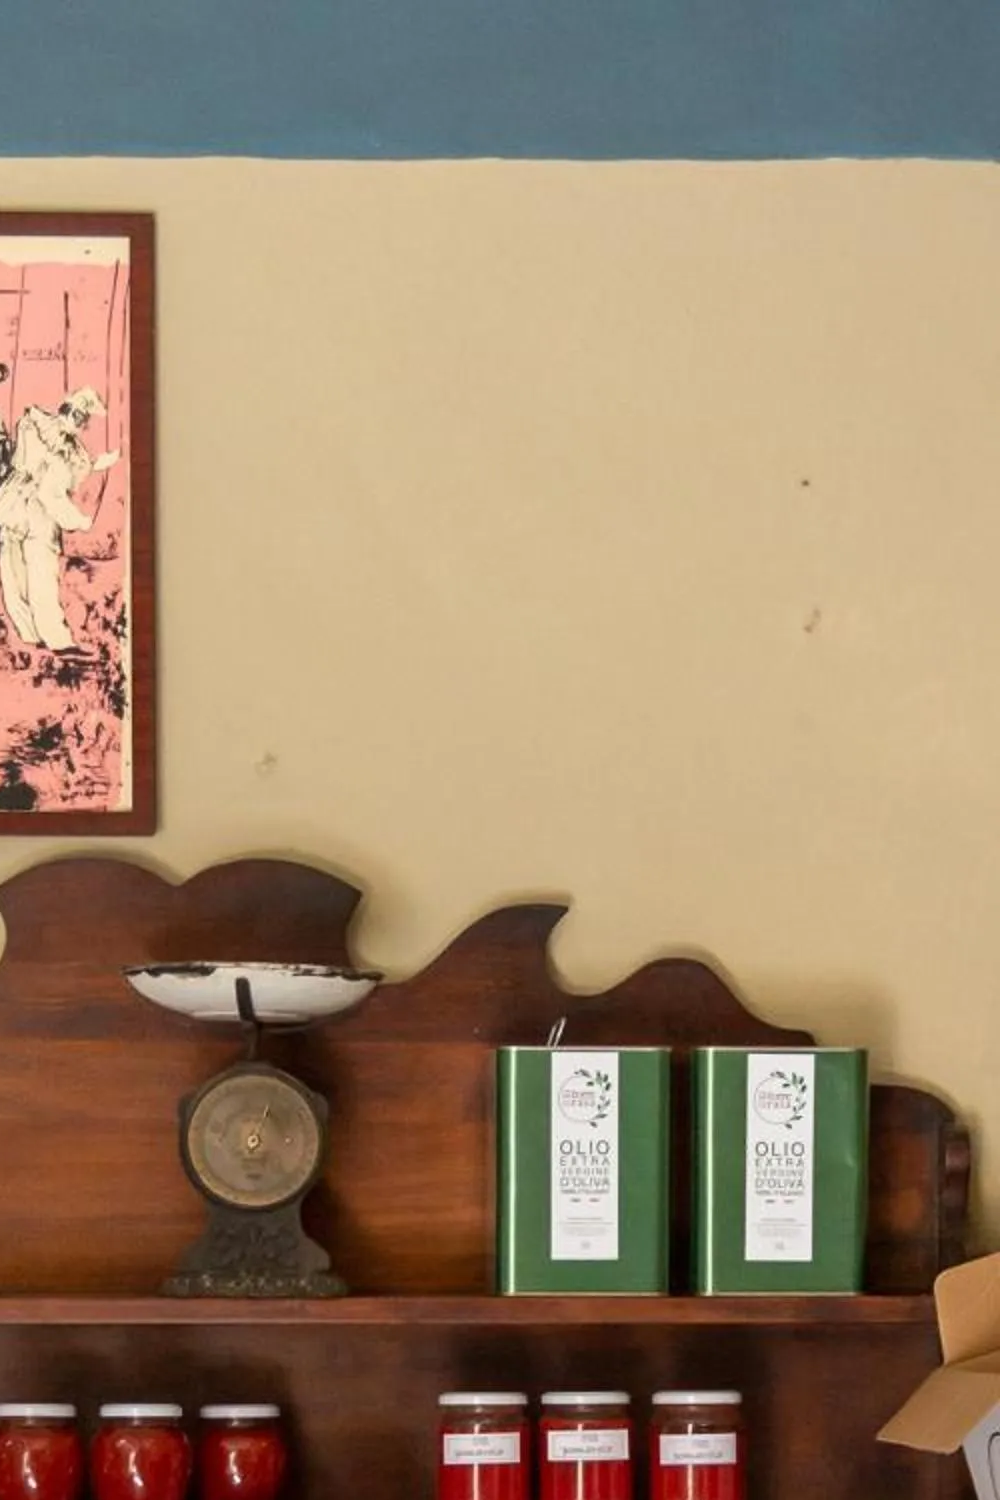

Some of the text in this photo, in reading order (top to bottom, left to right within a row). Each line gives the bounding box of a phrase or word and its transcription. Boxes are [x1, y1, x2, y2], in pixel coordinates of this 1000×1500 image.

[559, 1139, 611, 1156] OLIO
[755, 1141, 805, 1157] OLIO
[559, 1156, 611, 1167] EXTRA
[755, 1158, 805, 1168] EXTRA
[755, 1178, 805, 1189] D'OLIVA
